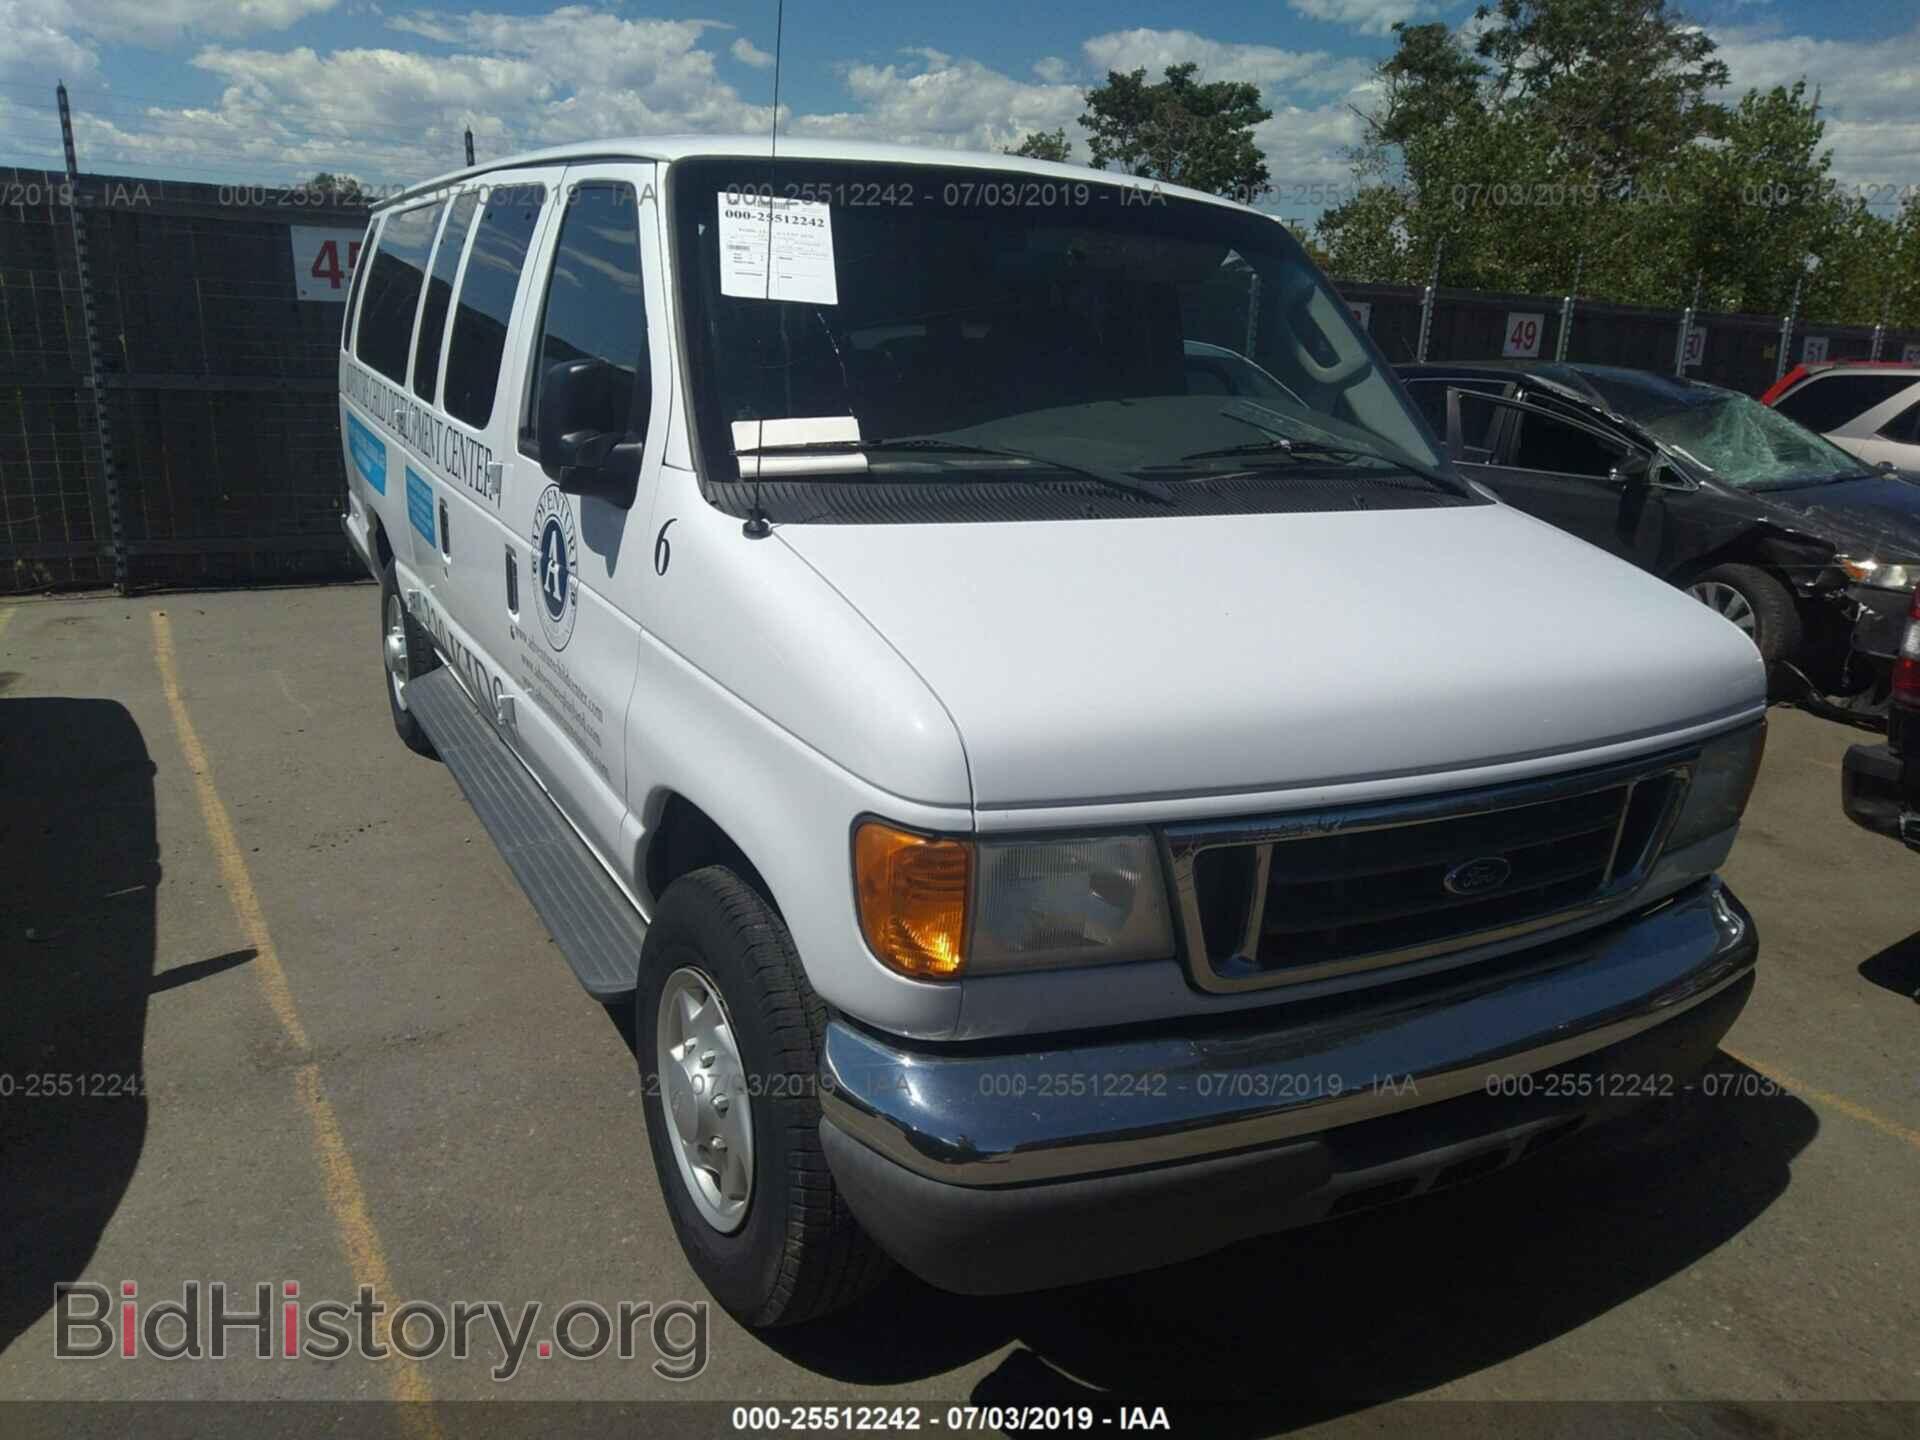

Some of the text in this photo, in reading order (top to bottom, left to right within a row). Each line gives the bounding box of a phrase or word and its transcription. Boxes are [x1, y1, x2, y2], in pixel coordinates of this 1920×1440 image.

[725, 209, 825, 228] 000-25512242
[1511, 320, 1537, 350] 49
[444, 426, 493, 499] CENTER
[655, 518, 678, 577] 6
